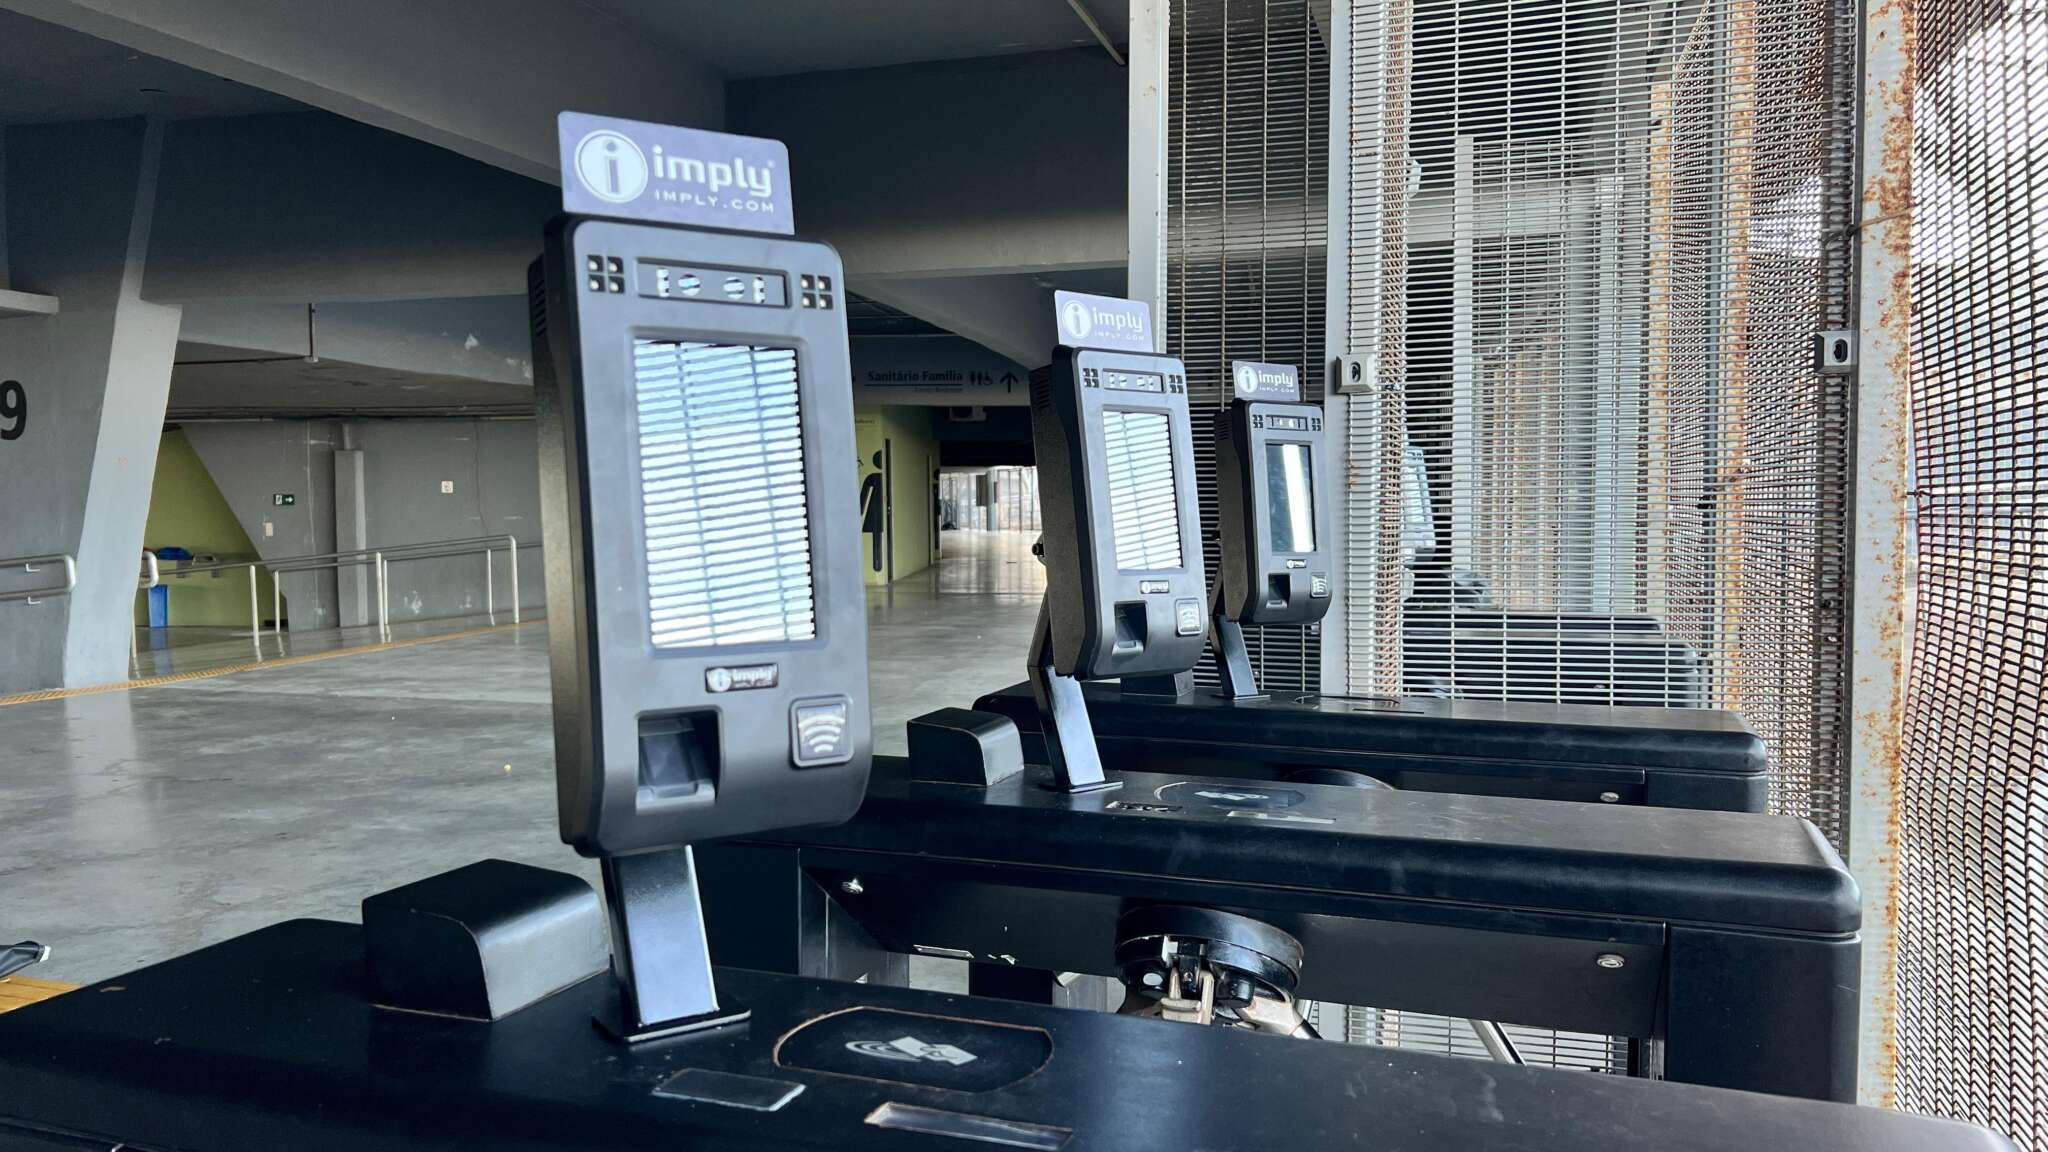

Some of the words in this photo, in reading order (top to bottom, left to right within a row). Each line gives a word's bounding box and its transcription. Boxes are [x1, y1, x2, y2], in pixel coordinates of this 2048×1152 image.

[655, 189, 774, 213] IMPLY.COM
[1092, 306, 1144, 333] imply
[1258, 369, 1294, 388] imply
[0, 380, 27, 440] 9
